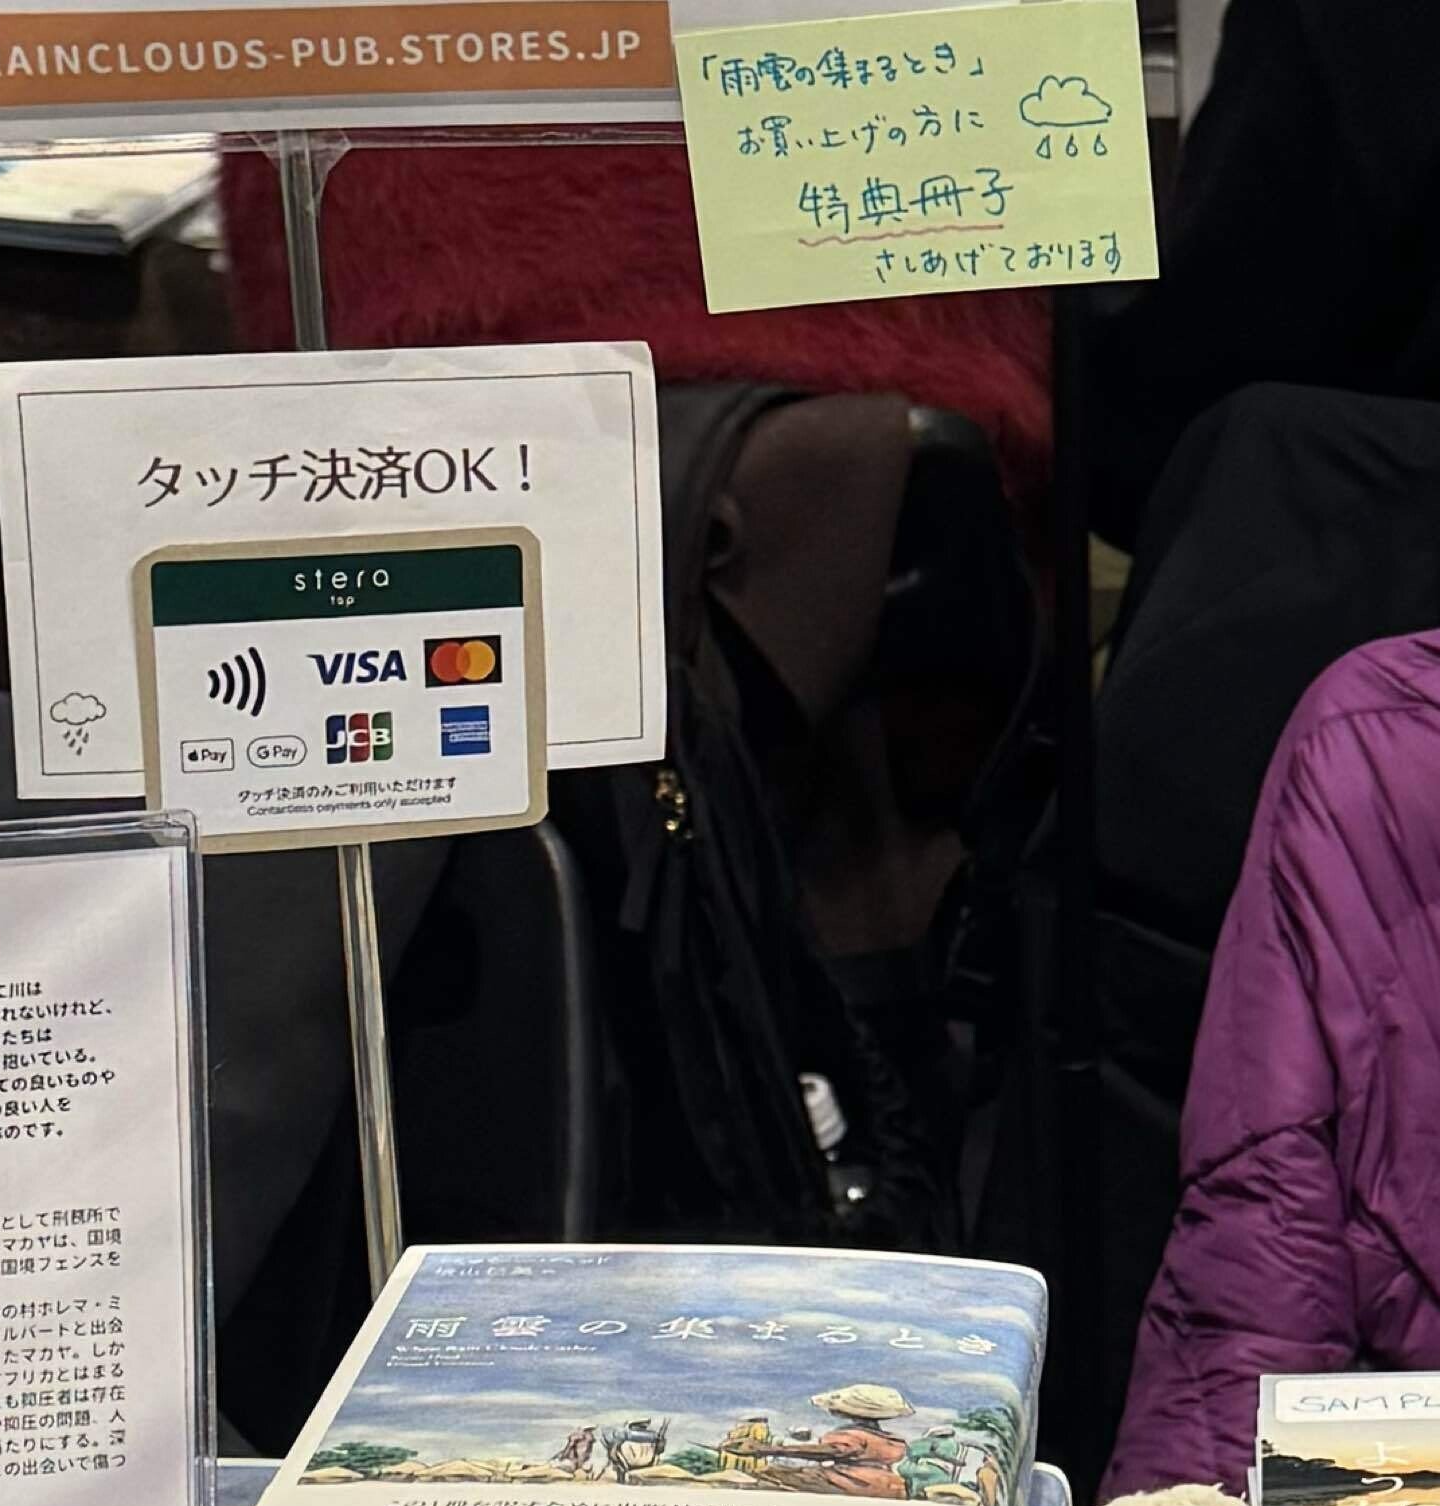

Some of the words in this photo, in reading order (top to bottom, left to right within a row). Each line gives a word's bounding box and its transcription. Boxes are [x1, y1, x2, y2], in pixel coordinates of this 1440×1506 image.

[702, 41, 985, 95] 「雨雲の集まるとき」
[738, 104, 984, 158] お買い上げの方に
[798, 167, 1014, 234] 特典冊子
[876, 231, 1123, 284] さしあげております
[136, 444, 533, 508] タッチ決済OK！
[294, 568, 391, 592] stera
[306, 650, 407, 686] VISA
[201, 749, 227, 765] Pay
[273, 744, 297, 762] Pay
[374, 796, 398, 811] only
[405, 1315, 998, 1356] 雨雲の集まるとき
